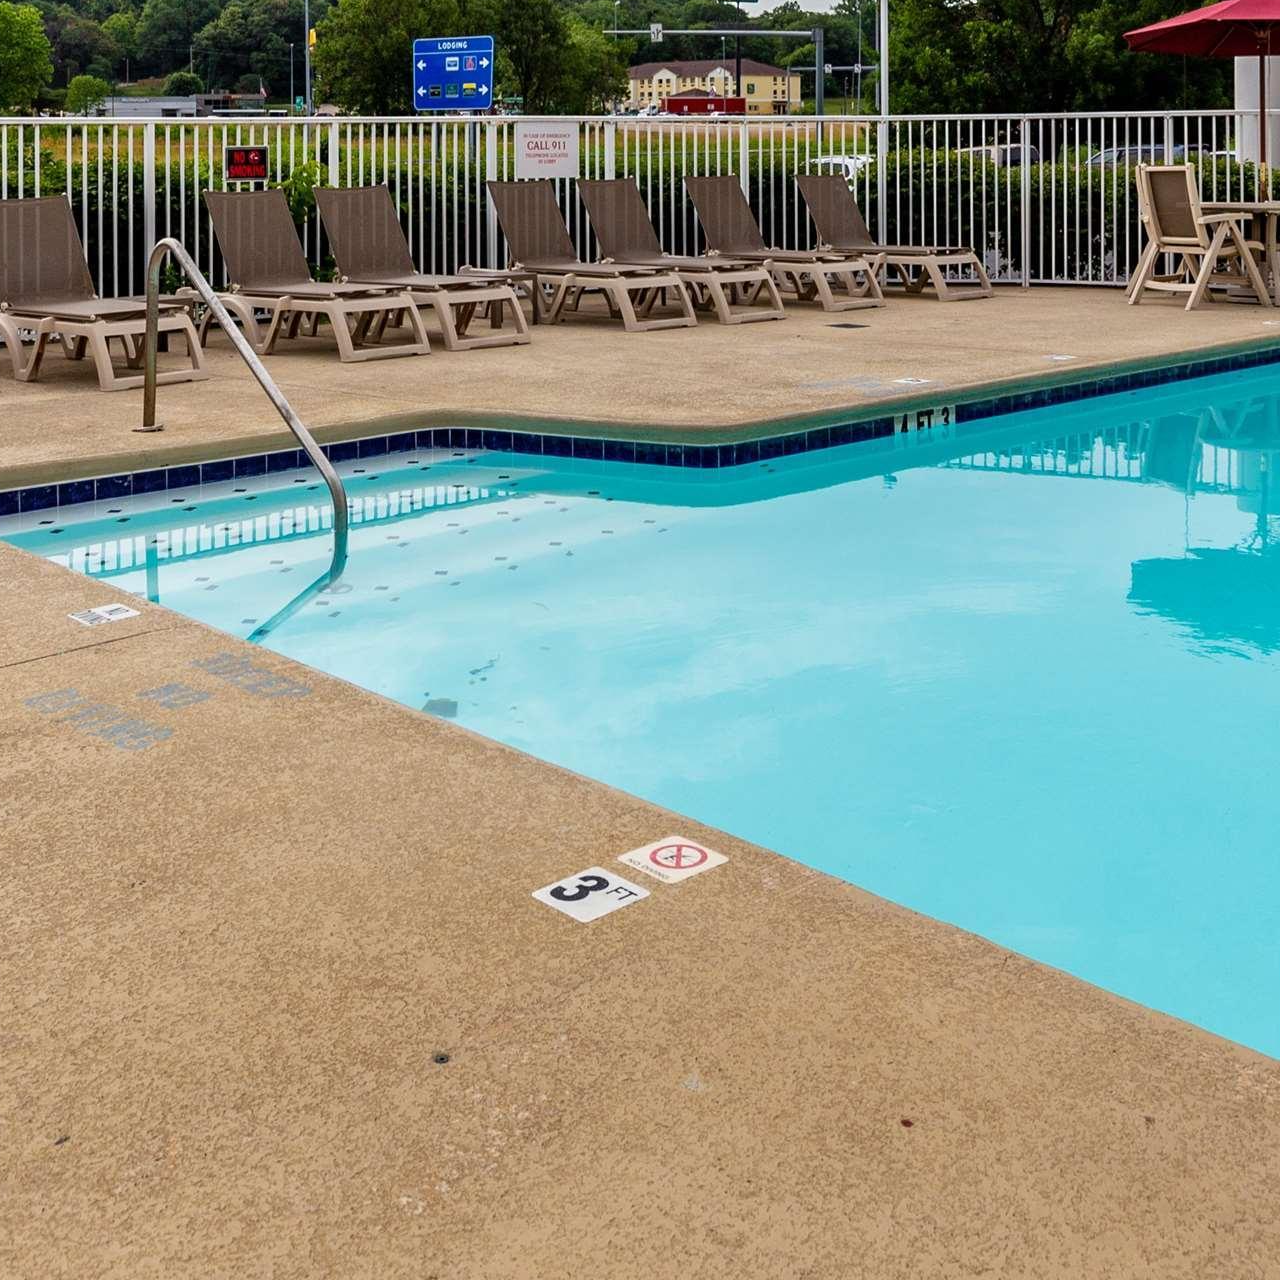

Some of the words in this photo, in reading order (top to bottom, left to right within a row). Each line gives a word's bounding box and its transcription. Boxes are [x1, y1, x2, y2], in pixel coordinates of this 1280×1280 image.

[437, 40, 468, 50] LODGING
[527, 141, 550, 150] CALL
[551, 141, 566, 150] 911
[233, 151, 245, 163] NO
[229, 165, 266, 177] SMOKING
[549, 874, 610, 902] 3
[605, 885, 639, 902] FT
